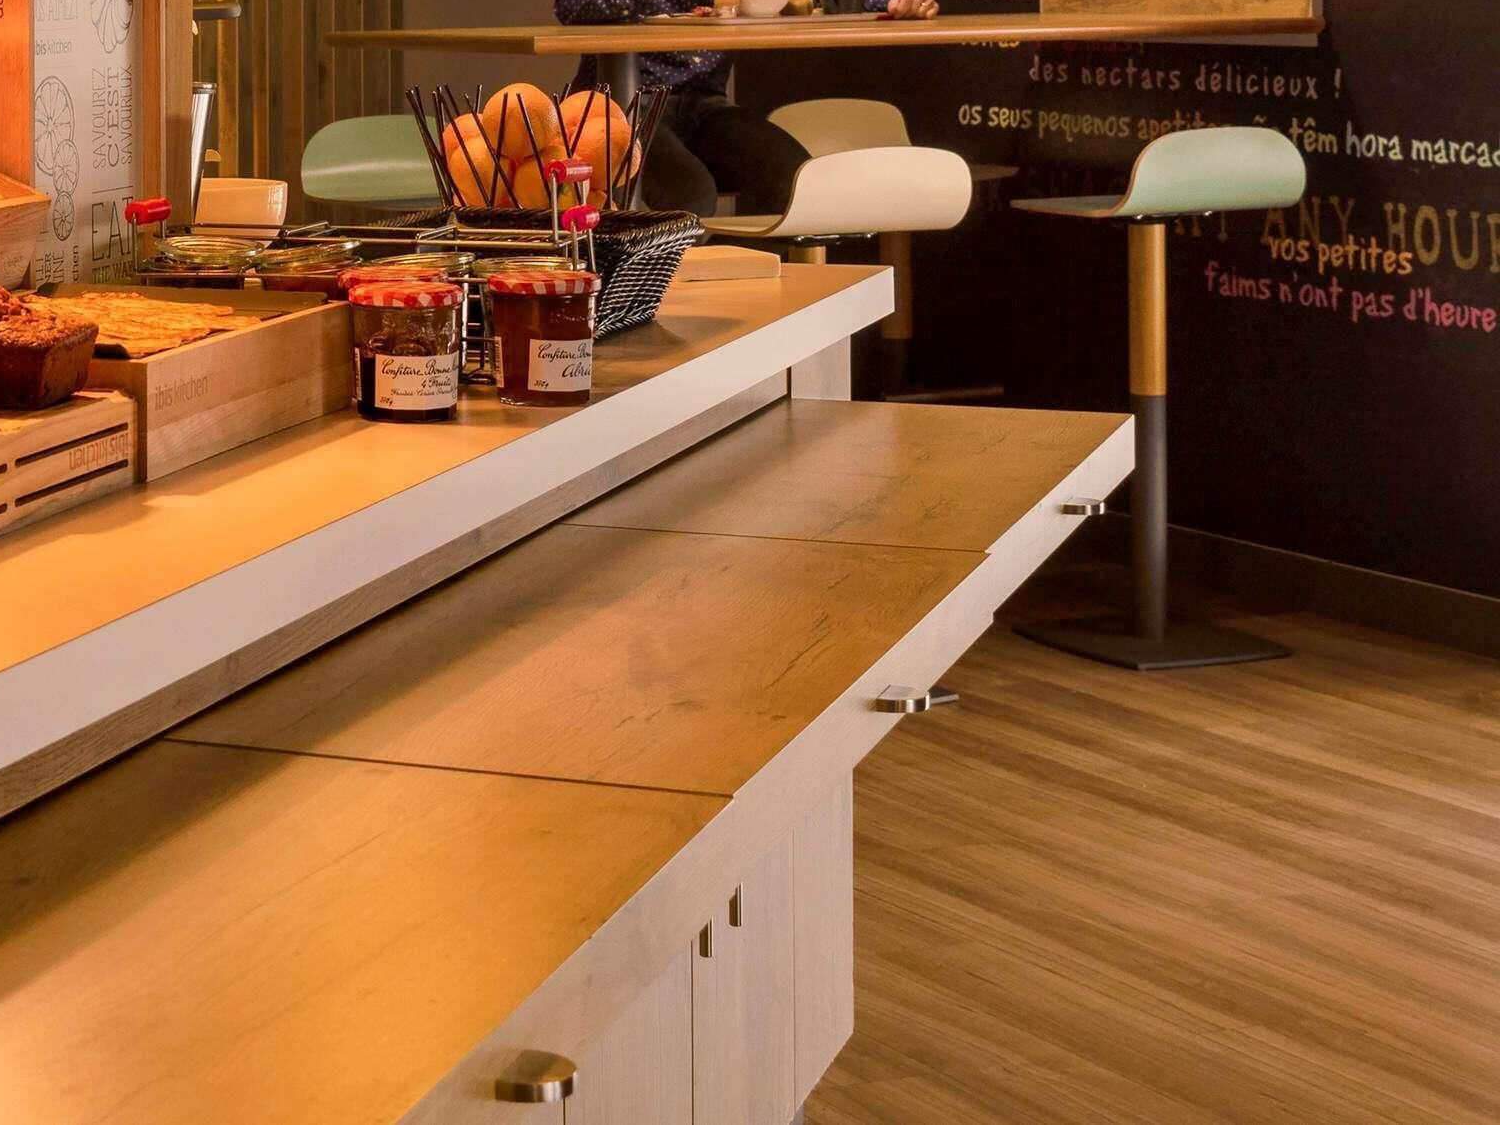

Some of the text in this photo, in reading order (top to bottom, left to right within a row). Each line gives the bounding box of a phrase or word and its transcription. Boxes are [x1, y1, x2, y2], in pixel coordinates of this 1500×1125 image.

[1028, 53, 1068, 83] des
[1080, 57, 1181, 92] nectars
[1195, 60, 1318, 100] délicieux
[957, 104, 982, 126] os
[988, 106, 1032, 131] seus
[1037, 108, 1131, 143] pequenos
[1346, 120, 1404, 162] hora
[1266, 233, 1414, 275] vos petites
[1202, 259, 1497, 333] faims n'ont pas d'heure
